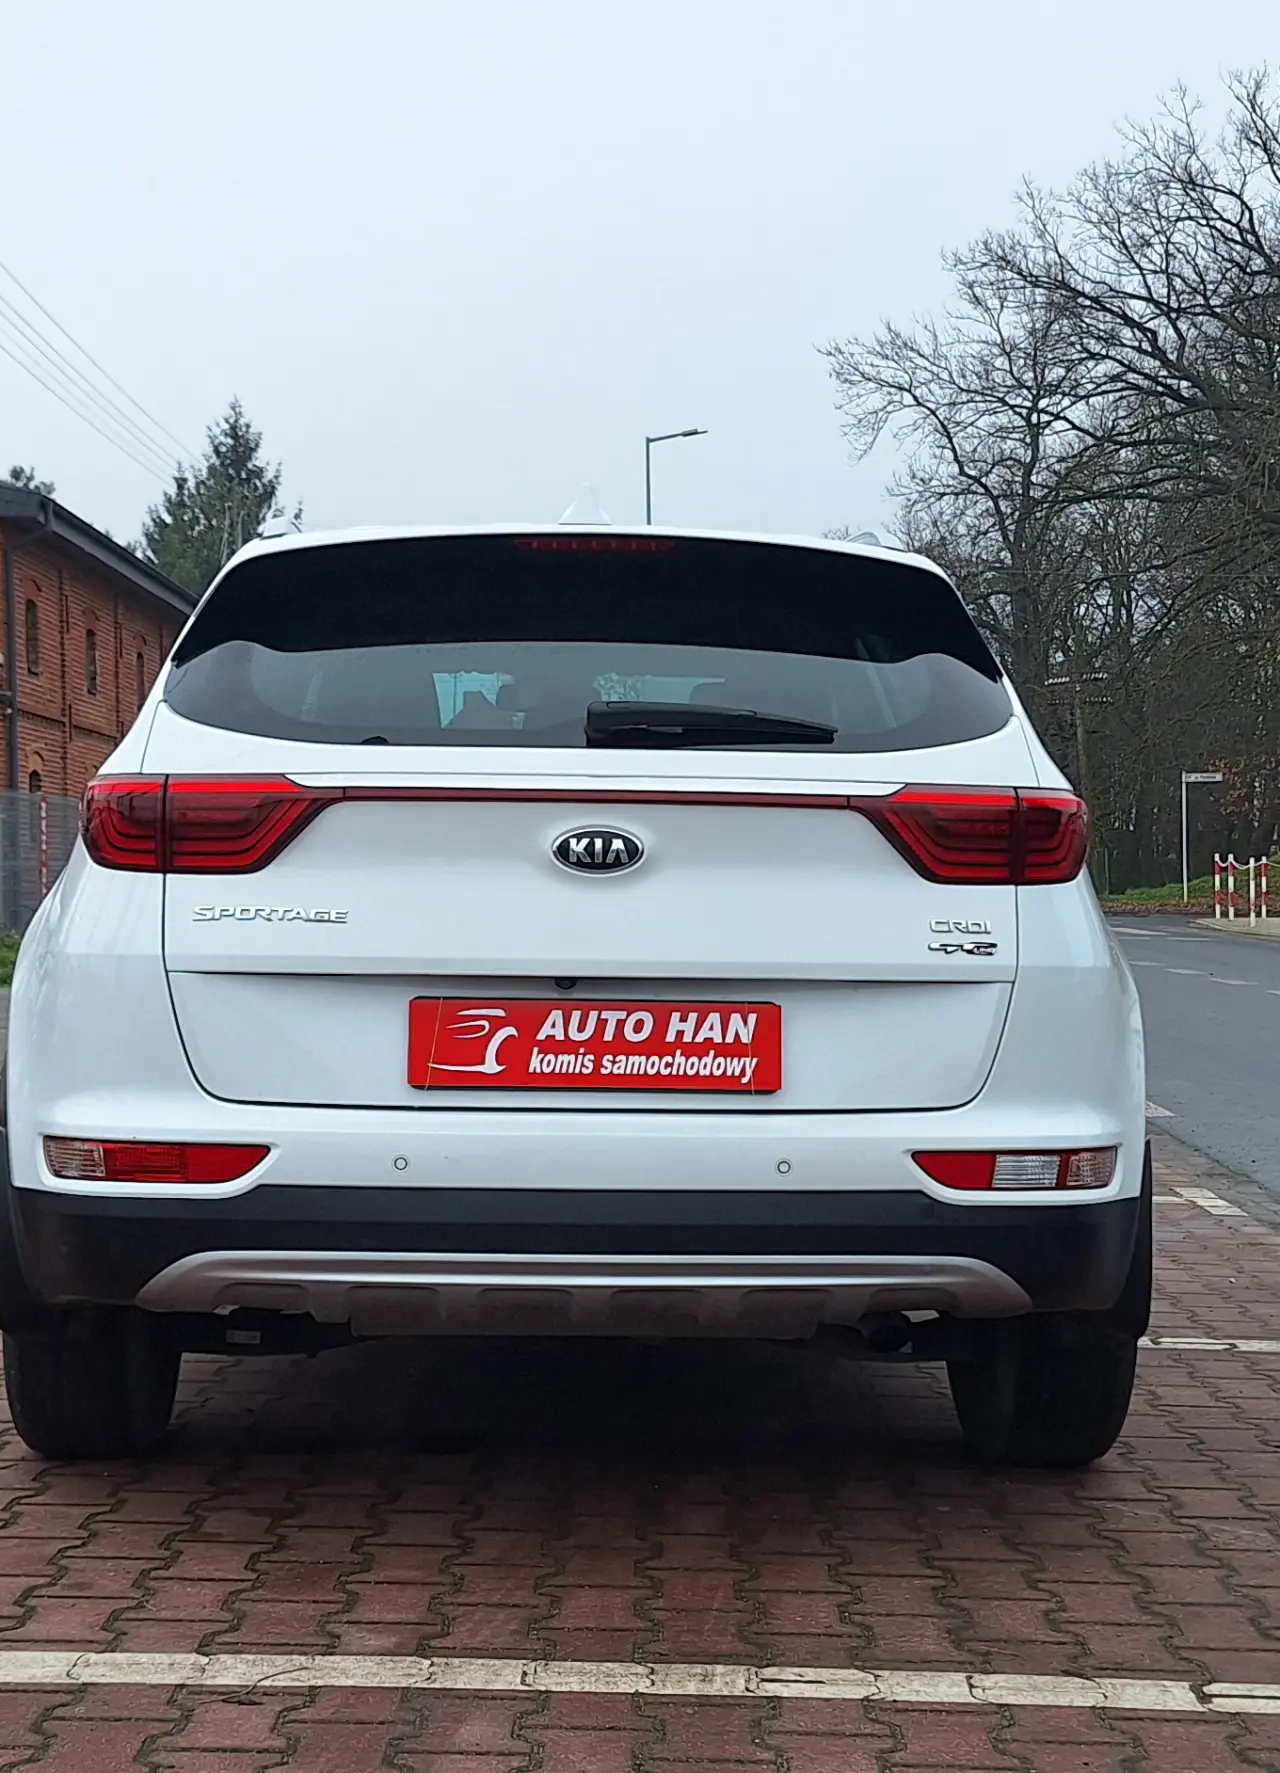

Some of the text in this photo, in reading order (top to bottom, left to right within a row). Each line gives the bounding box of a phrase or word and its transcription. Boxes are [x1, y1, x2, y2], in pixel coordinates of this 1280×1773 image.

[568, 837, 629, 864] KIA
[192, 904, 349, 924] SPORTAGE
[535, 1009, 758, 1044] AUTO HAN
[528, 1046, 758, 1084] komis samochodowy
